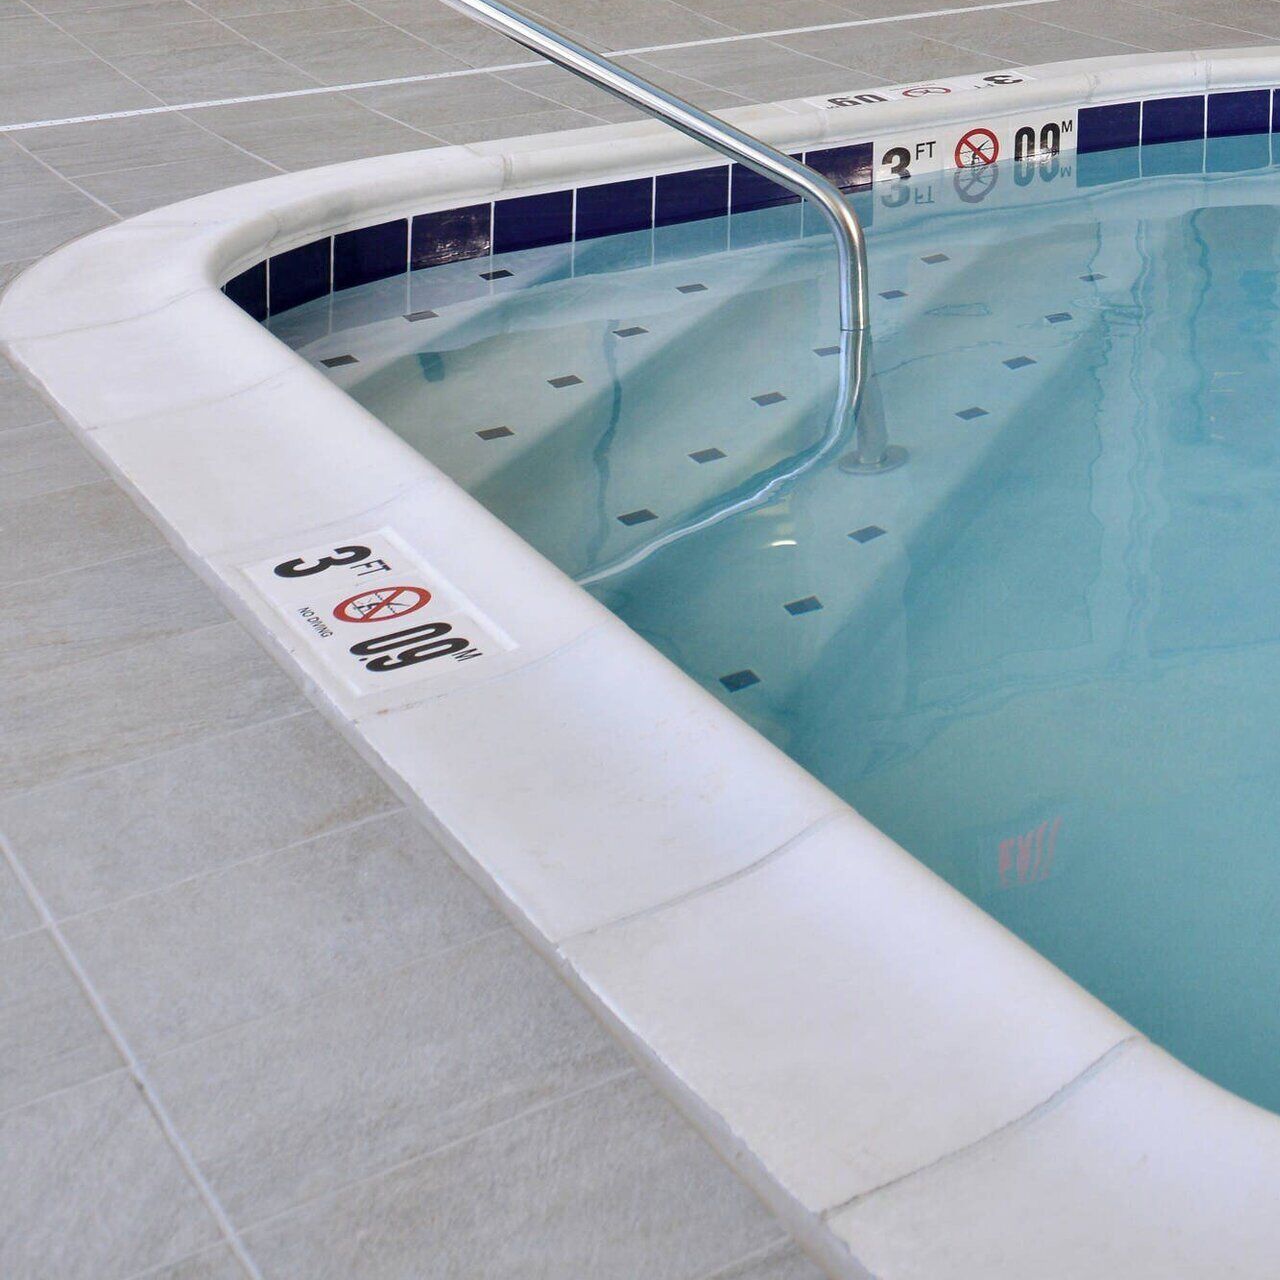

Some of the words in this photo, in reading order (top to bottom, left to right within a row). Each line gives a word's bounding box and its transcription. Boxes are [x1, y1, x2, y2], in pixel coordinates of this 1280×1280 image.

[881, 147, 911, 180] 3
[915, 140, 937, 160] FT
[1061, 119, 1073, 133] M
[273, 545, 372, 579] 3
[350, 558, 393, 577] FT
[451, 647, 484, 663] M
[298, 606, 315, 618] NO
[306, 616, 334, 638] DIVING
